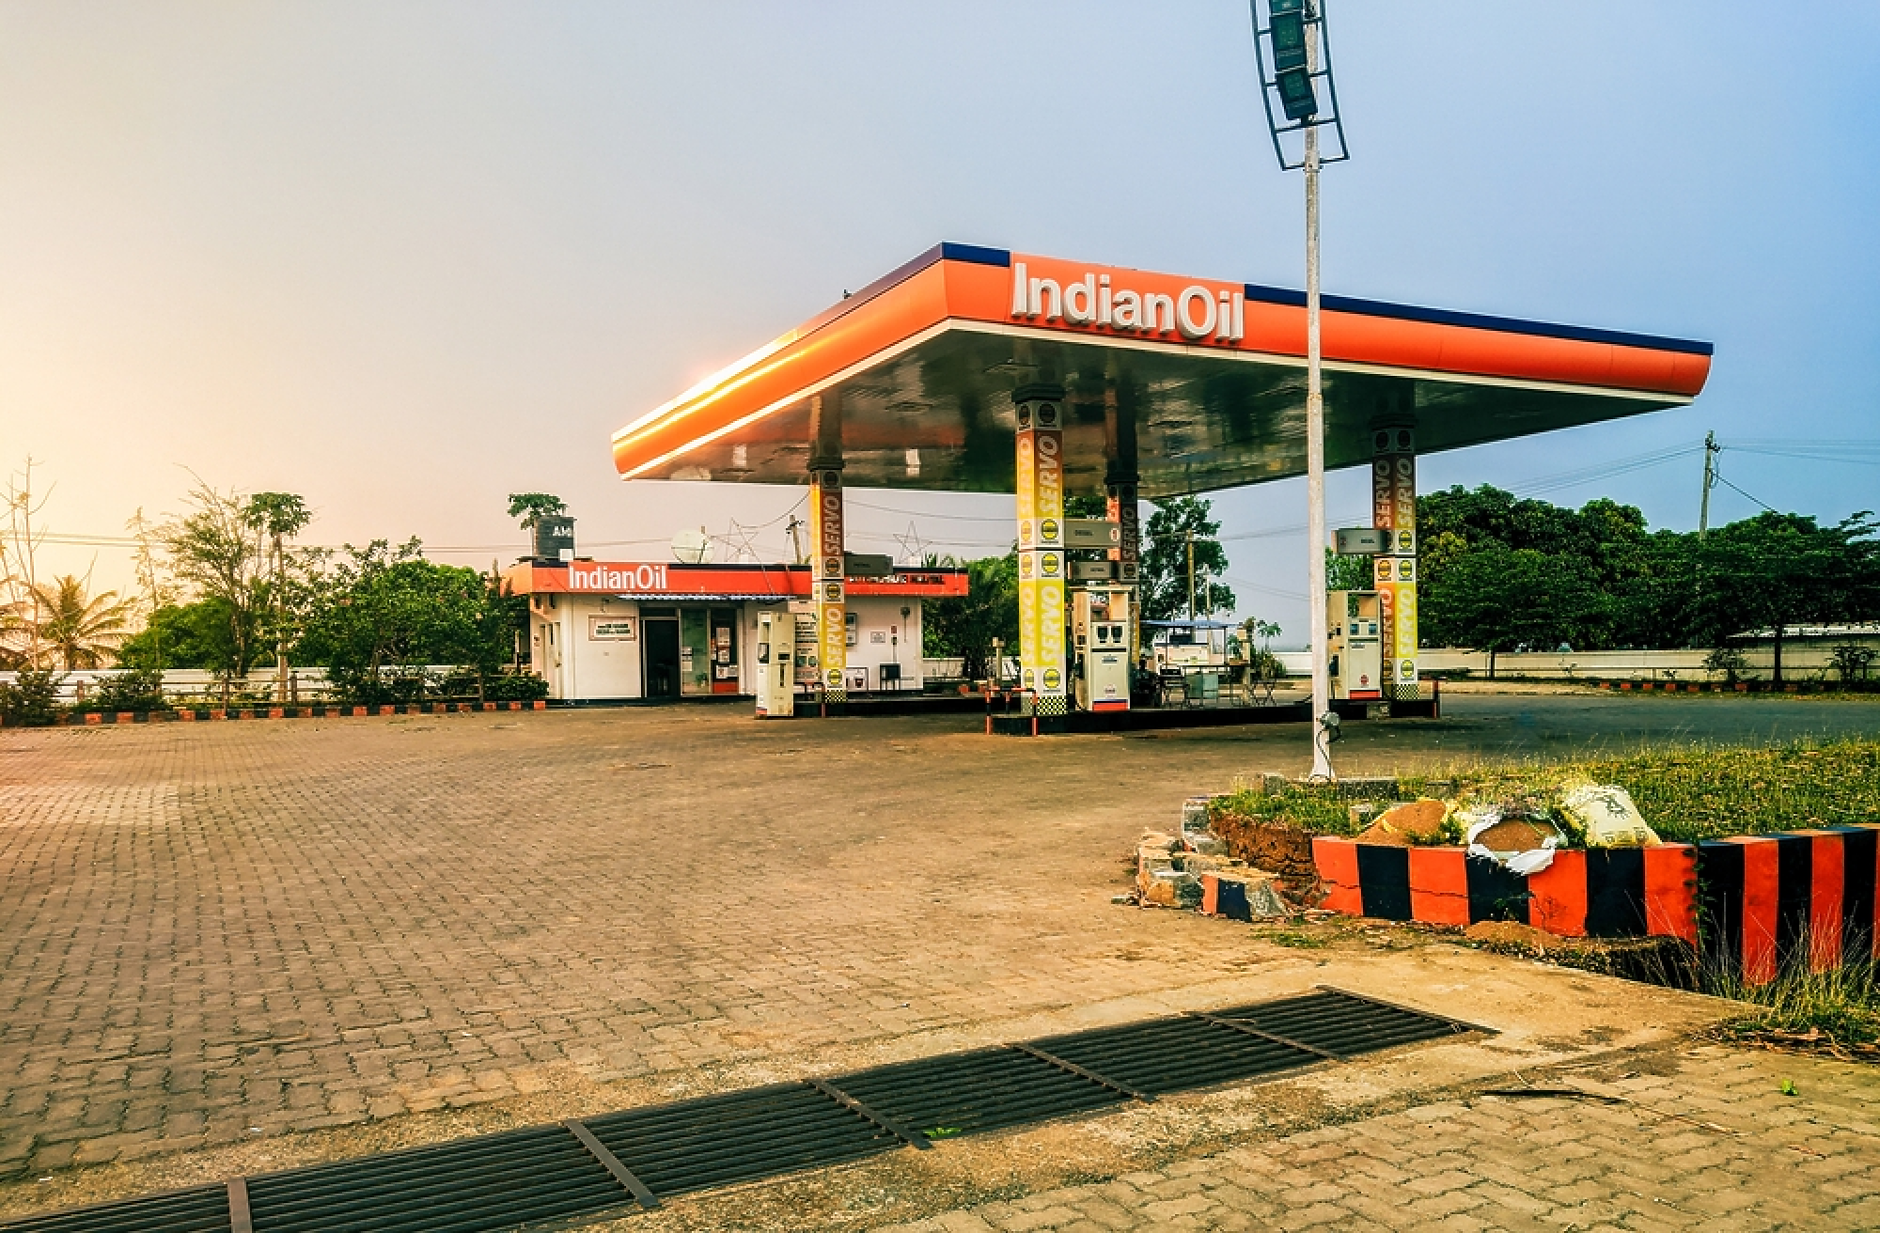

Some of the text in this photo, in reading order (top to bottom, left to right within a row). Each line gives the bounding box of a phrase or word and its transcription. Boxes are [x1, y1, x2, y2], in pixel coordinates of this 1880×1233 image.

[1012, 262, 1244, 341] IndianOil
[1038, 435, 1058, 515] SERVO
[1376, 460, 1391, 527] SERVO
[1397, 458, 1412, 527] SERVO
[825, 495, 840, 555] SERVO
[1123, 507, 1136, 562] SERVO
[569, 565, 667, 589] IndianOil
[827, 609, 842, 666] SERVO
[1022, 586, 1034, 665] SERVO
[1041, 585, 1061, 662] SERVO
[1400, 589, 1414, 656] SERVO
